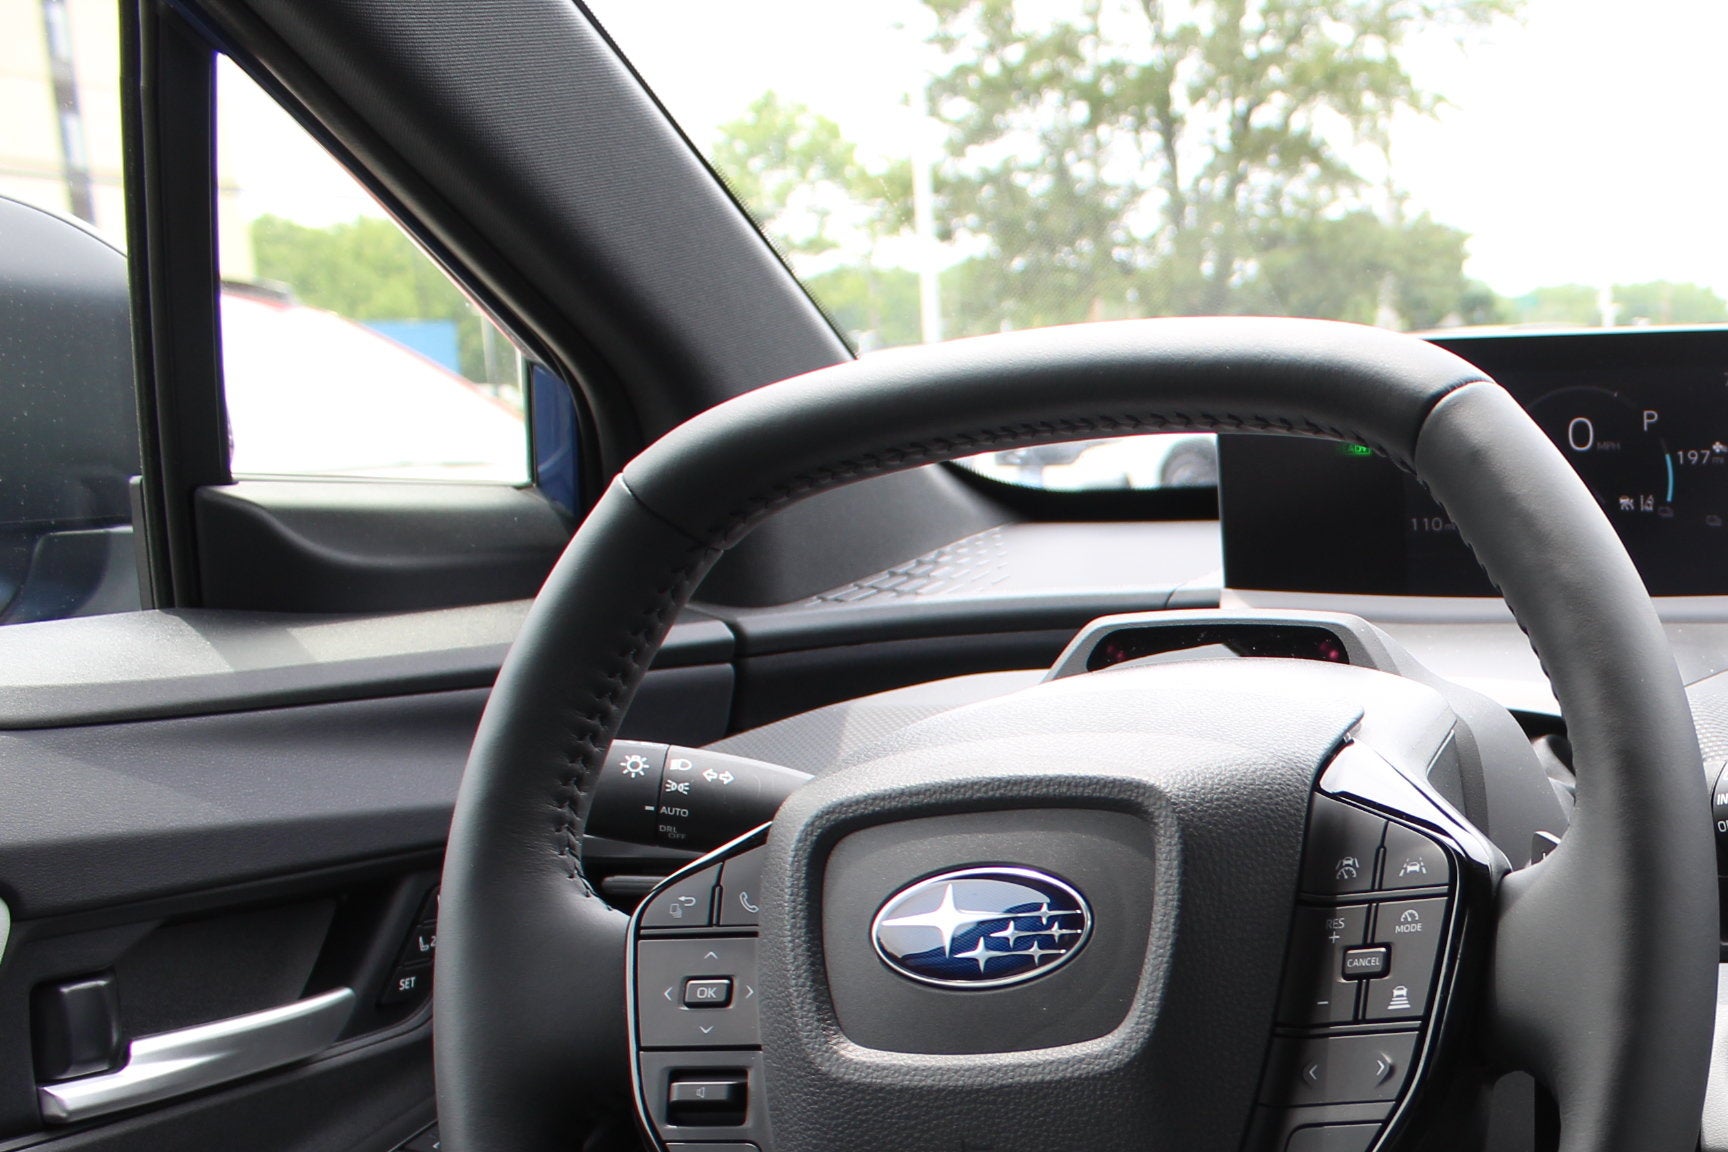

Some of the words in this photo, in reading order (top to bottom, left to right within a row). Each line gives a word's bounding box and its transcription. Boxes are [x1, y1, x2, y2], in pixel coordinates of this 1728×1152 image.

[1644, 410, 1658, 431] P
[1678, 451, 1710, 464] 197
[1411, 518, 1443, 531] 110
[660, 806, 688, 817] AUTO
[659, 825, 679, 835] DRL
[1326, 918, 1345, 929] RES
[1395, 920, 1421, 933] MODE
[1348, 957, 1379, 967] CANCEL
[399, 977, 415, 990] SET
[697, 987, 716, 998] OK
